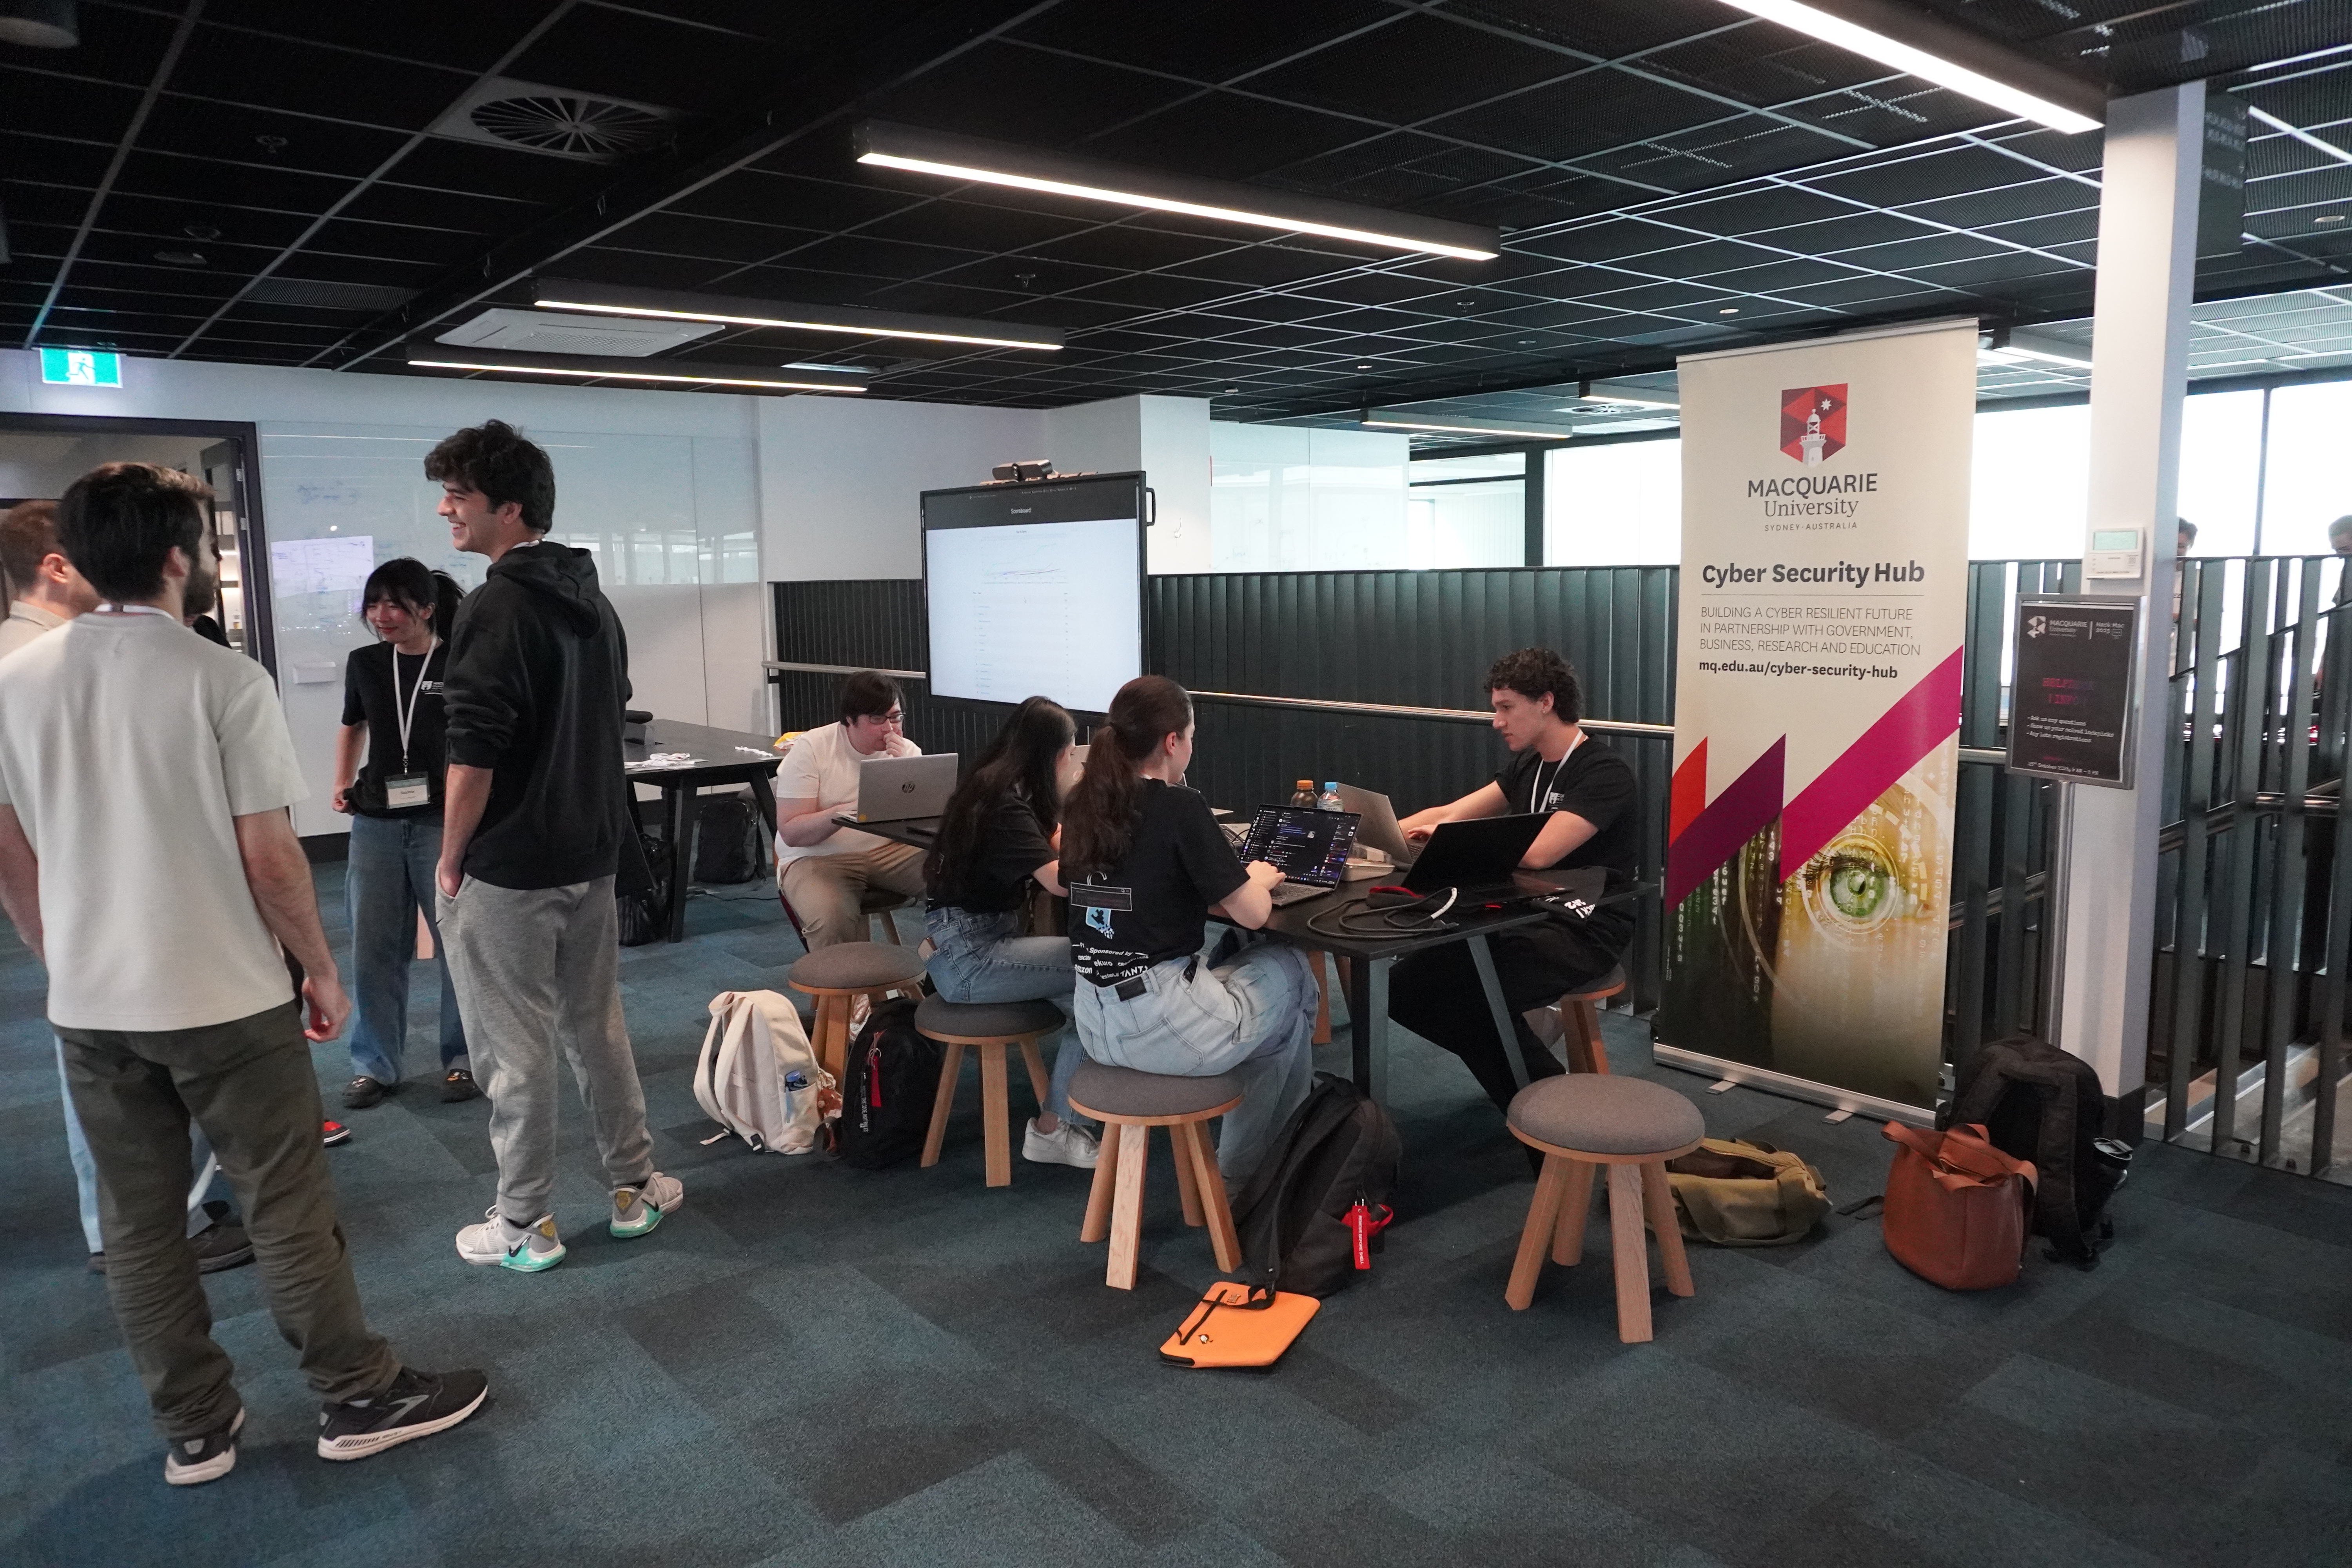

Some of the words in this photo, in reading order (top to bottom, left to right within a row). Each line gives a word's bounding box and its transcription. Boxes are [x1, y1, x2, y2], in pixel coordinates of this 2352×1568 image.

[1748, 474, 1877, 498] MACQUARIE
[1765, 497, 1858, 517] University
[1703, 564, 1767, 588] Cyber
[1773, 561, 1869, 588] Security
[1875, 560, 1924, 582] Hub
[1702, 607, 1751, 617] BUILDING
[1755, 608, 1762, 617] A
[1766, 608, 1802, 618] CYBER
[1807, 608, 1862, 619] RESILIENT
[1866, 608, 1912, 620] FUTURE
[1701, 623, 1710, 633] IN
[1715, 623, 1789, 634] PARTNERSHIP
[1793, 625, 1823, 635] WITH
[1827, 625, 1912, 637] GOVERNMENT,
[1700, 639, 1753, 652] BUSINESS,
[1759, 641, 1817, 652] RESEARCH
[1821, 642, 1846, 653] AND
[1850, 643, 1920, 655] EDUCATION
[1700, 661, 1897, 680] mq.edu.au/cyber-security-hub
[902, 782, 915, 793] hp
[1089, 947, 1124, 955] Sponsored
[1074, 964, 1093, 974] amzon
